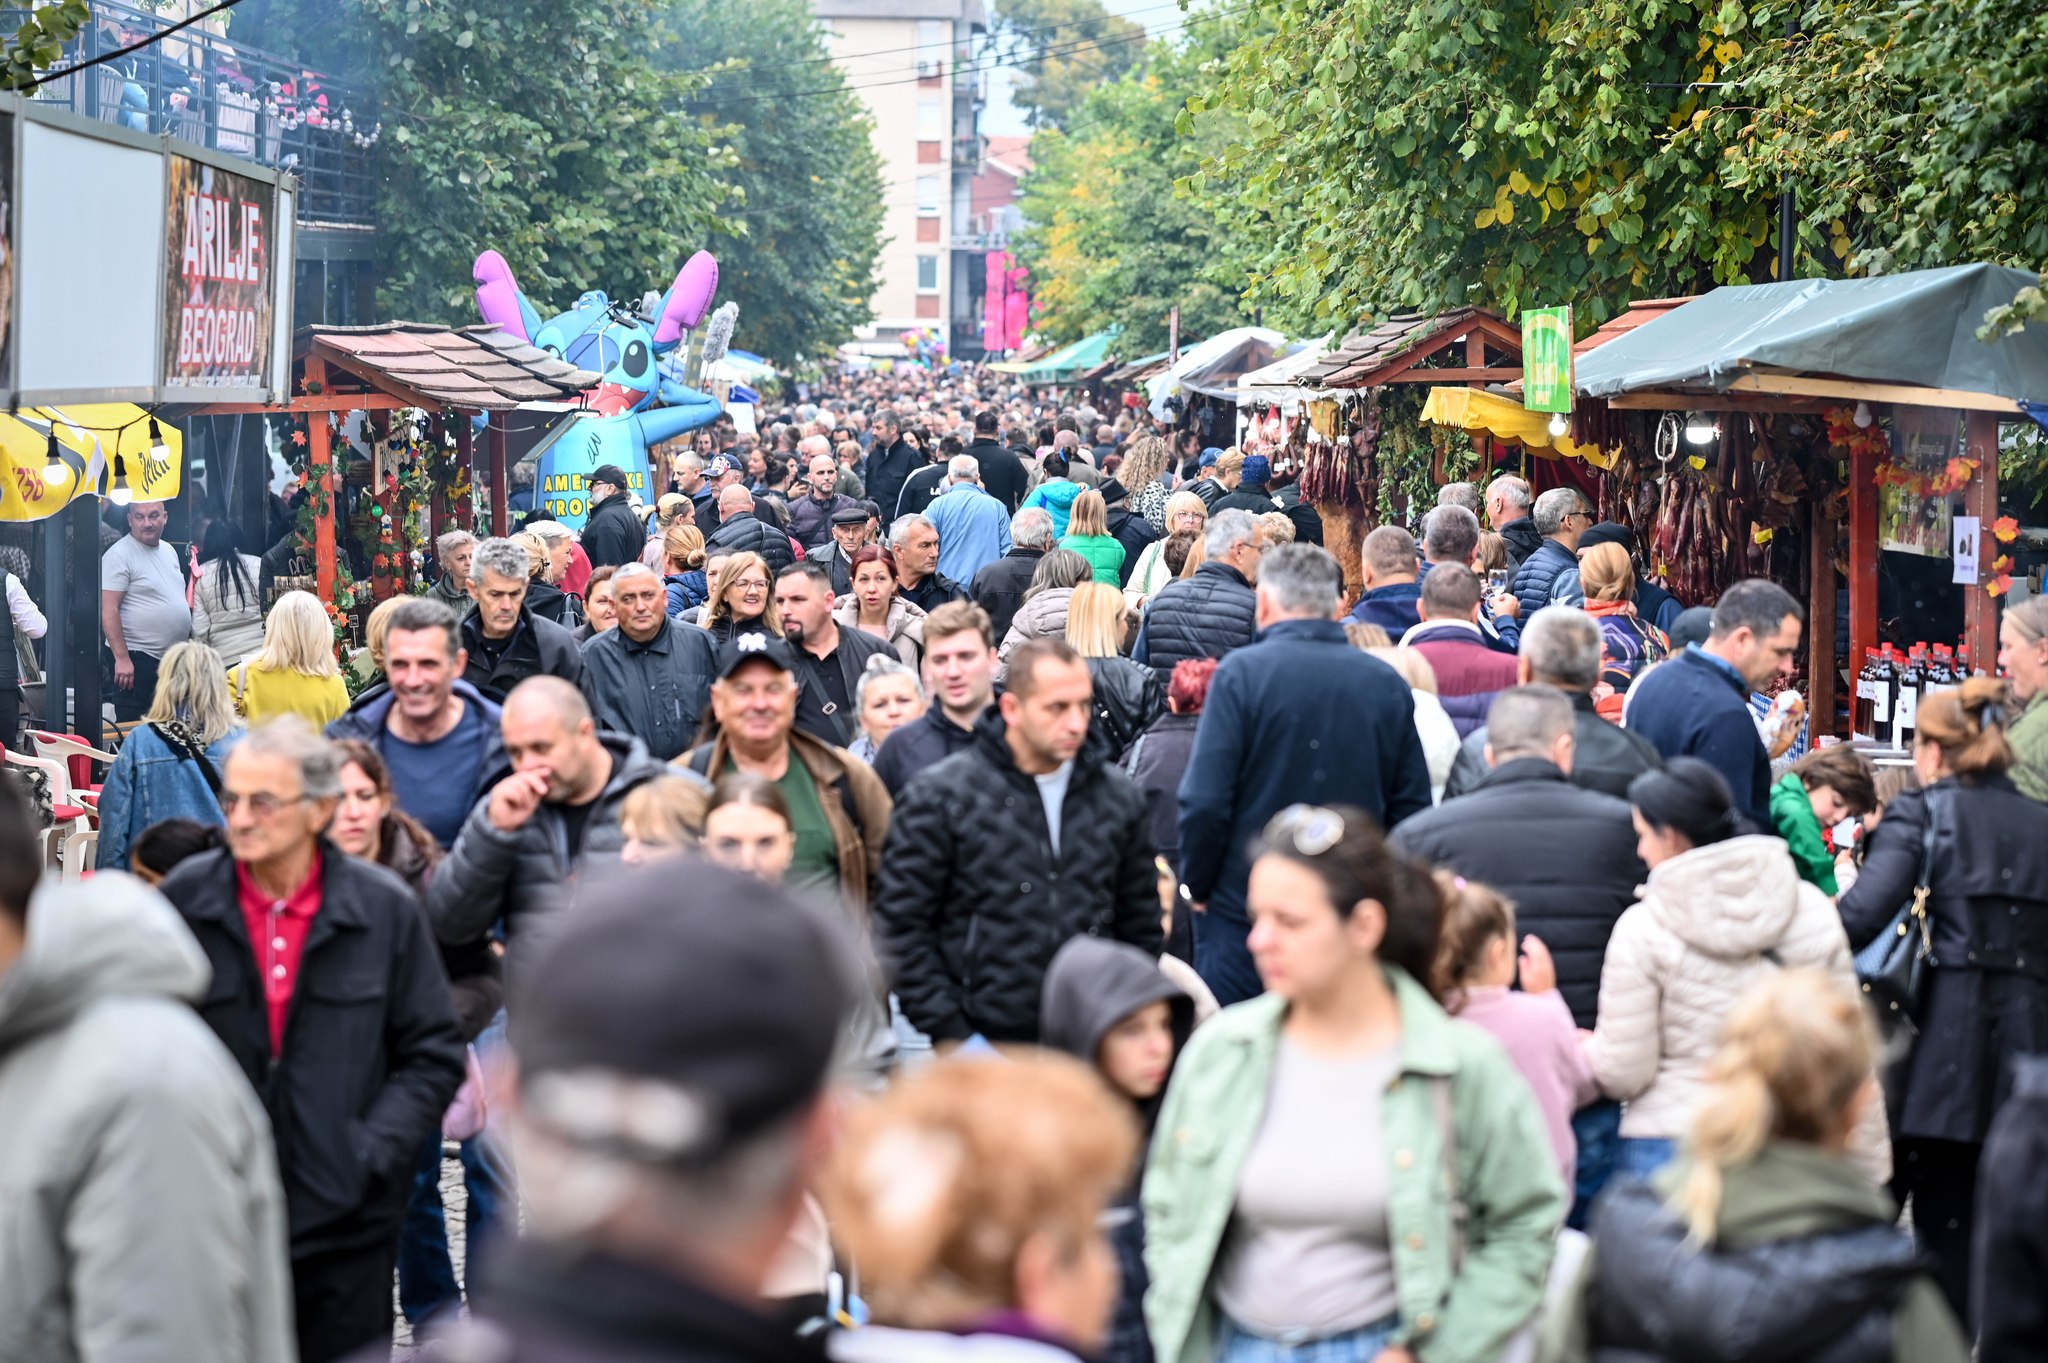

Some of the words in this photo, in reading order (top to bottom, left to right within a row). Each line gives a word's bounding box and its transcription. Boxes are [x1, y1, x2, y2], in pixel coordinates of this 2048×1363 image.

[182, 192, 261, 284] ARILJE
[179, 303, 256, 367] BEOGRAD
[12, 466, 45, 503] 756
[543, 472, 643, 493] AMEKE
